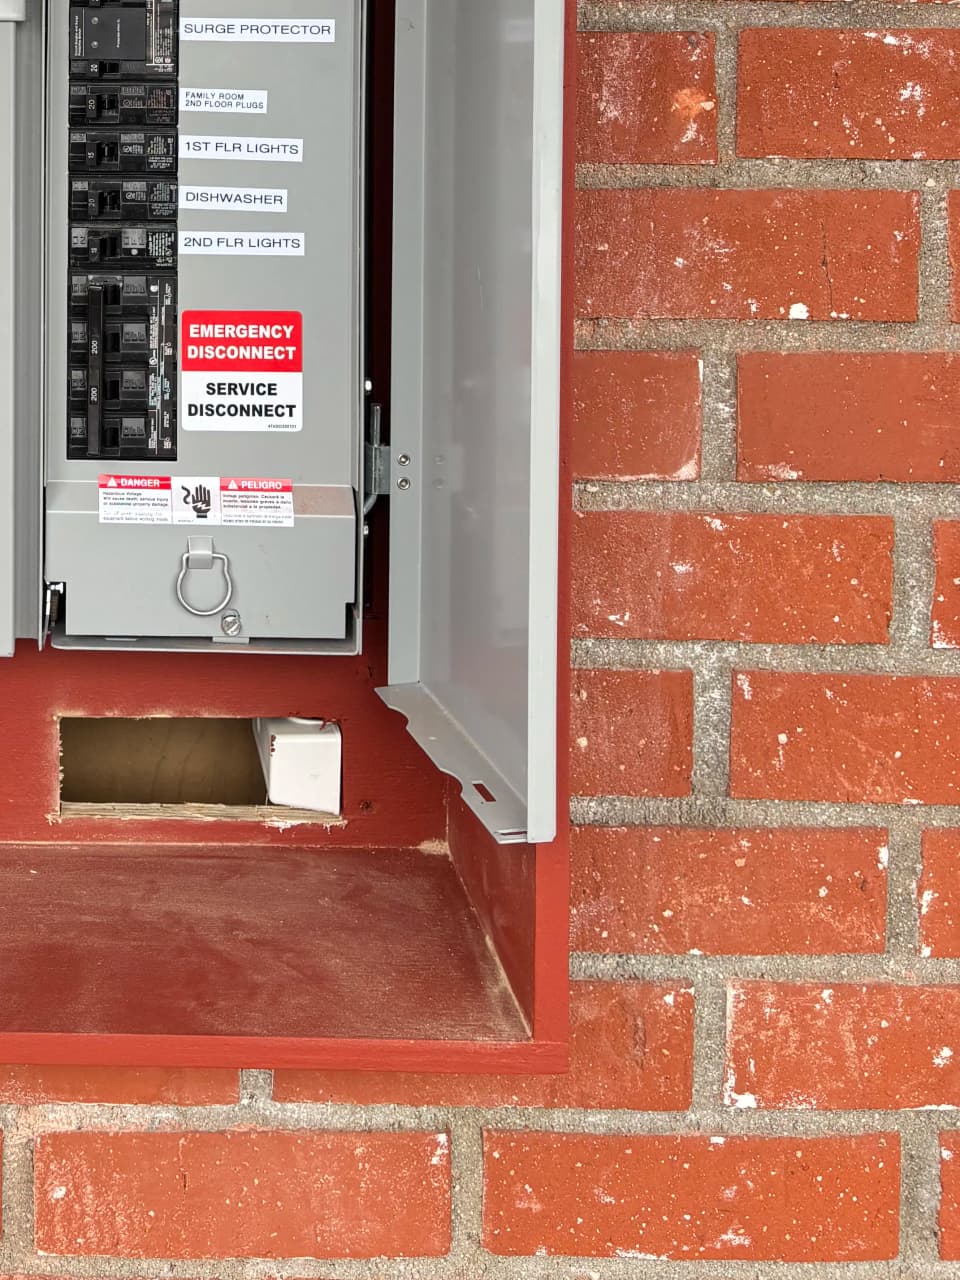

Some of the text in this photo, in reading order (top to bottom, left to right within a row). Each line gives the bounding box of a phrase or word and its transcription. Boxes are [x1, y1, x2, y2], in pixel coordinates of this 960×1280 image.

[184, 23, 331, 35] SURGE PROTECTOR
[91, 64, 98, 72] 20
[185, 92, 244, 100] FAMILY ROOM
[88, 99, 95, 110] 20
[185, 100, 264, 109] 2ND FLOOR PLUGS
[185, 142, 299, 155] 1ST FLR LIGHTS
[88, 198, 95, 207] 20
[185, 192, 283, 205] DISHWASHER
[183, 237, 301, 249] 2ND FLR LIGHTS
[189, 324, 294, 339] EMERGENCY
[188, 345, 296, 360] DISCONNECT
[206, 382, 277, 396] SERVICE
[188, 403, 297, 418] DISCONNECT
[120, 478, 160, 487] DANGER
[241, 480, 282, 490] PELIGRO
